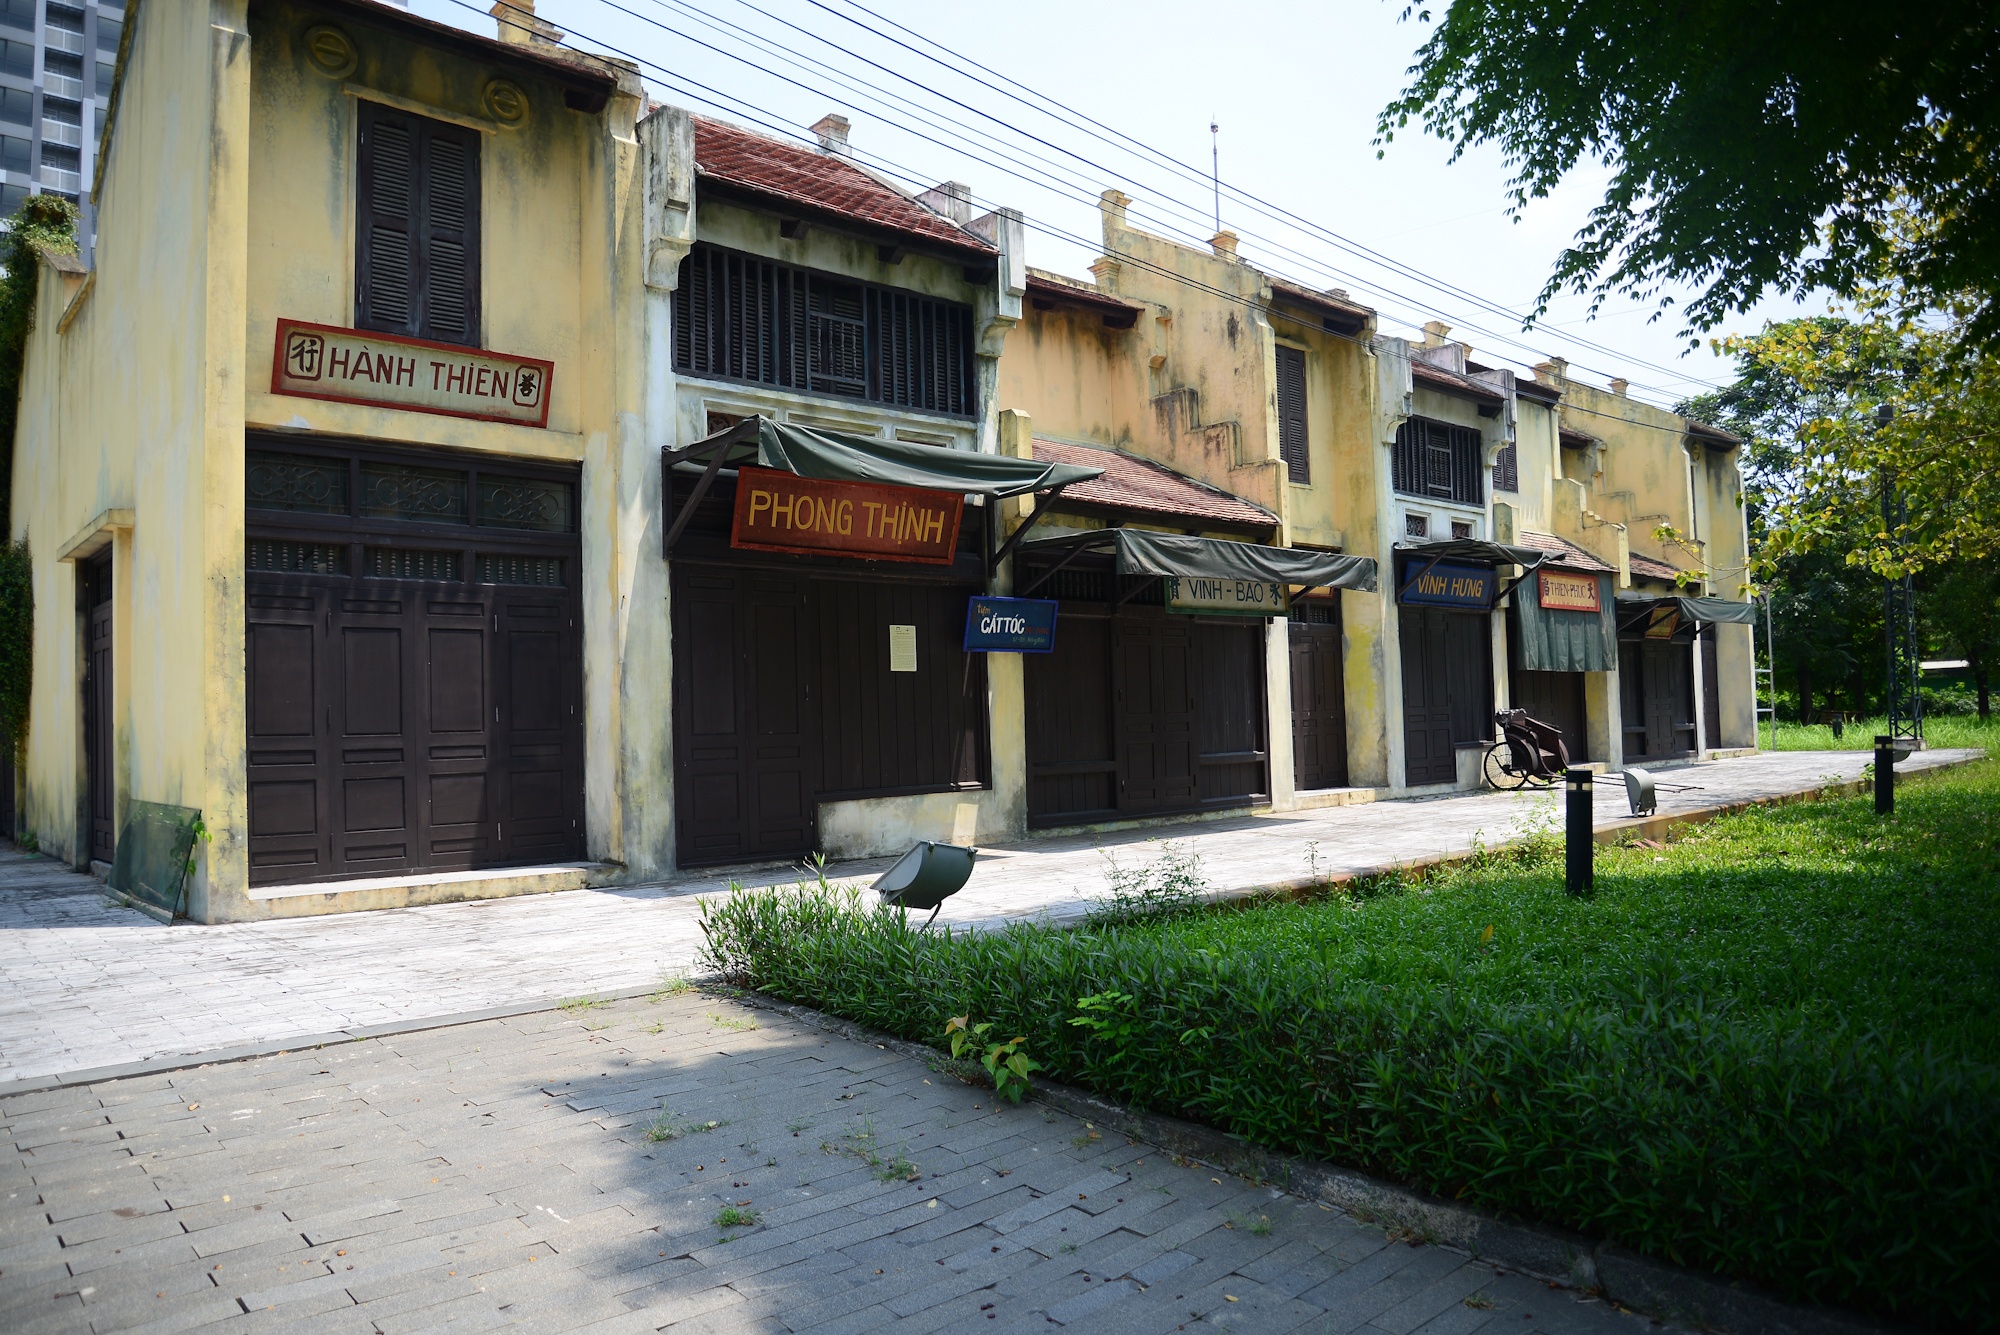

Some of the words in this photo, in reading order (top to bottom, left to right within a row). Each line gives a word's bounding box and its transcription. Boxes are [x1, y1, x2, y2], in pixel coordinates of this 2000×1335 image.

[290, 338, 318, 373] 行
[328, 345, 416, 388] HÀNH
[749, 490, 854, 536] PHONG
[862, 501, 945, 545] THỊNH
